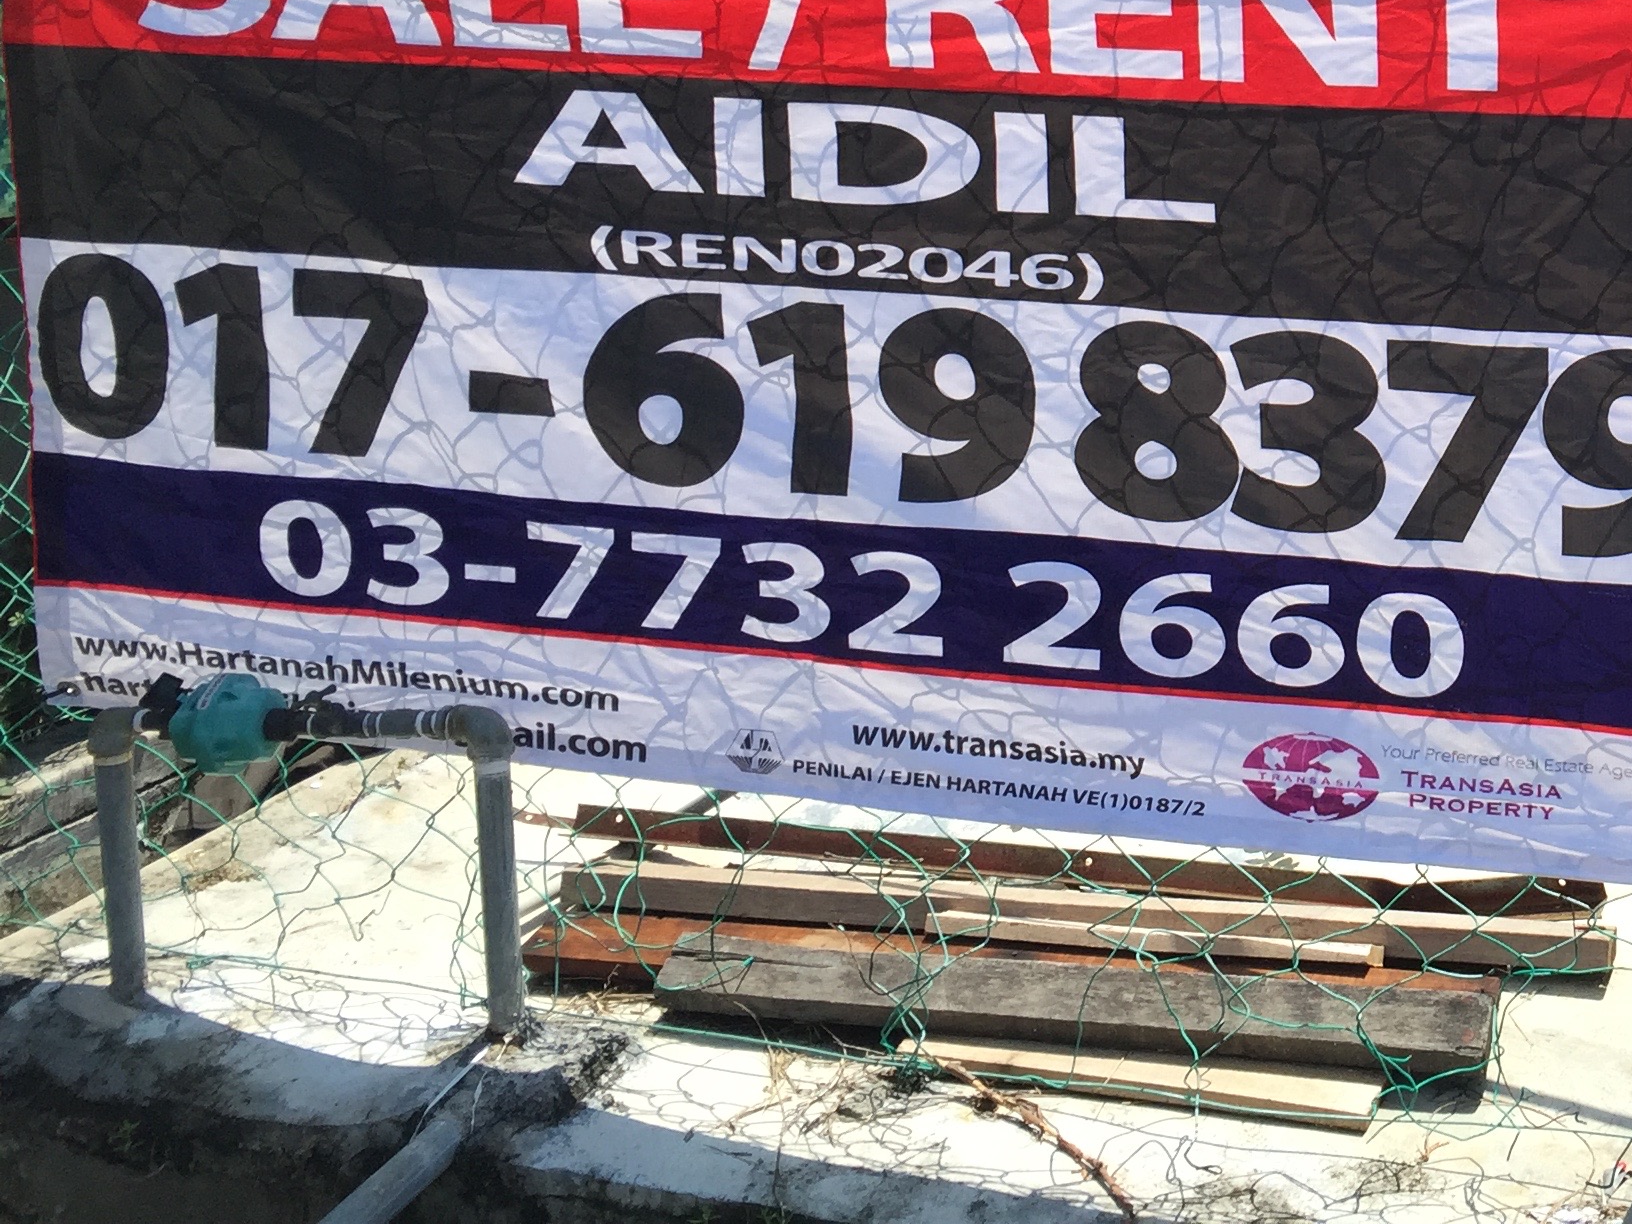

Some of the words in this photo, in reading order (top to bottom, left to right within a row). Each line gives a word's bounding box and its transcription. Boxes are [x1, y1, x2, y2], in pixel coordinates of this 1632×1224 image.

[513, 89, 1217, 224] AIDIL
[259, 499, 944, 659] 03-7732
[1003, 560, 1466, 699] 2660
[74, 635, 620, 713] www.HartanahMilenium.com
[852, 723, 1146, 779] www.transasia.my
[1381, 744, 1420, 760] Your
[1424, 747, 1500, 767] Preferred
[1506, 755, 1539, 771] Real
[1544, 758, 1594, 774] Estate
[792, 759, 872, 782] PENILAI
[891, 769, 941, 790] EJEN
[946, 775, 1068, 803] HARTANAH
[1072, 788, 1206, 818] VE(1)0187/2
[1408, 792, 1555, 820] PROPERTY
